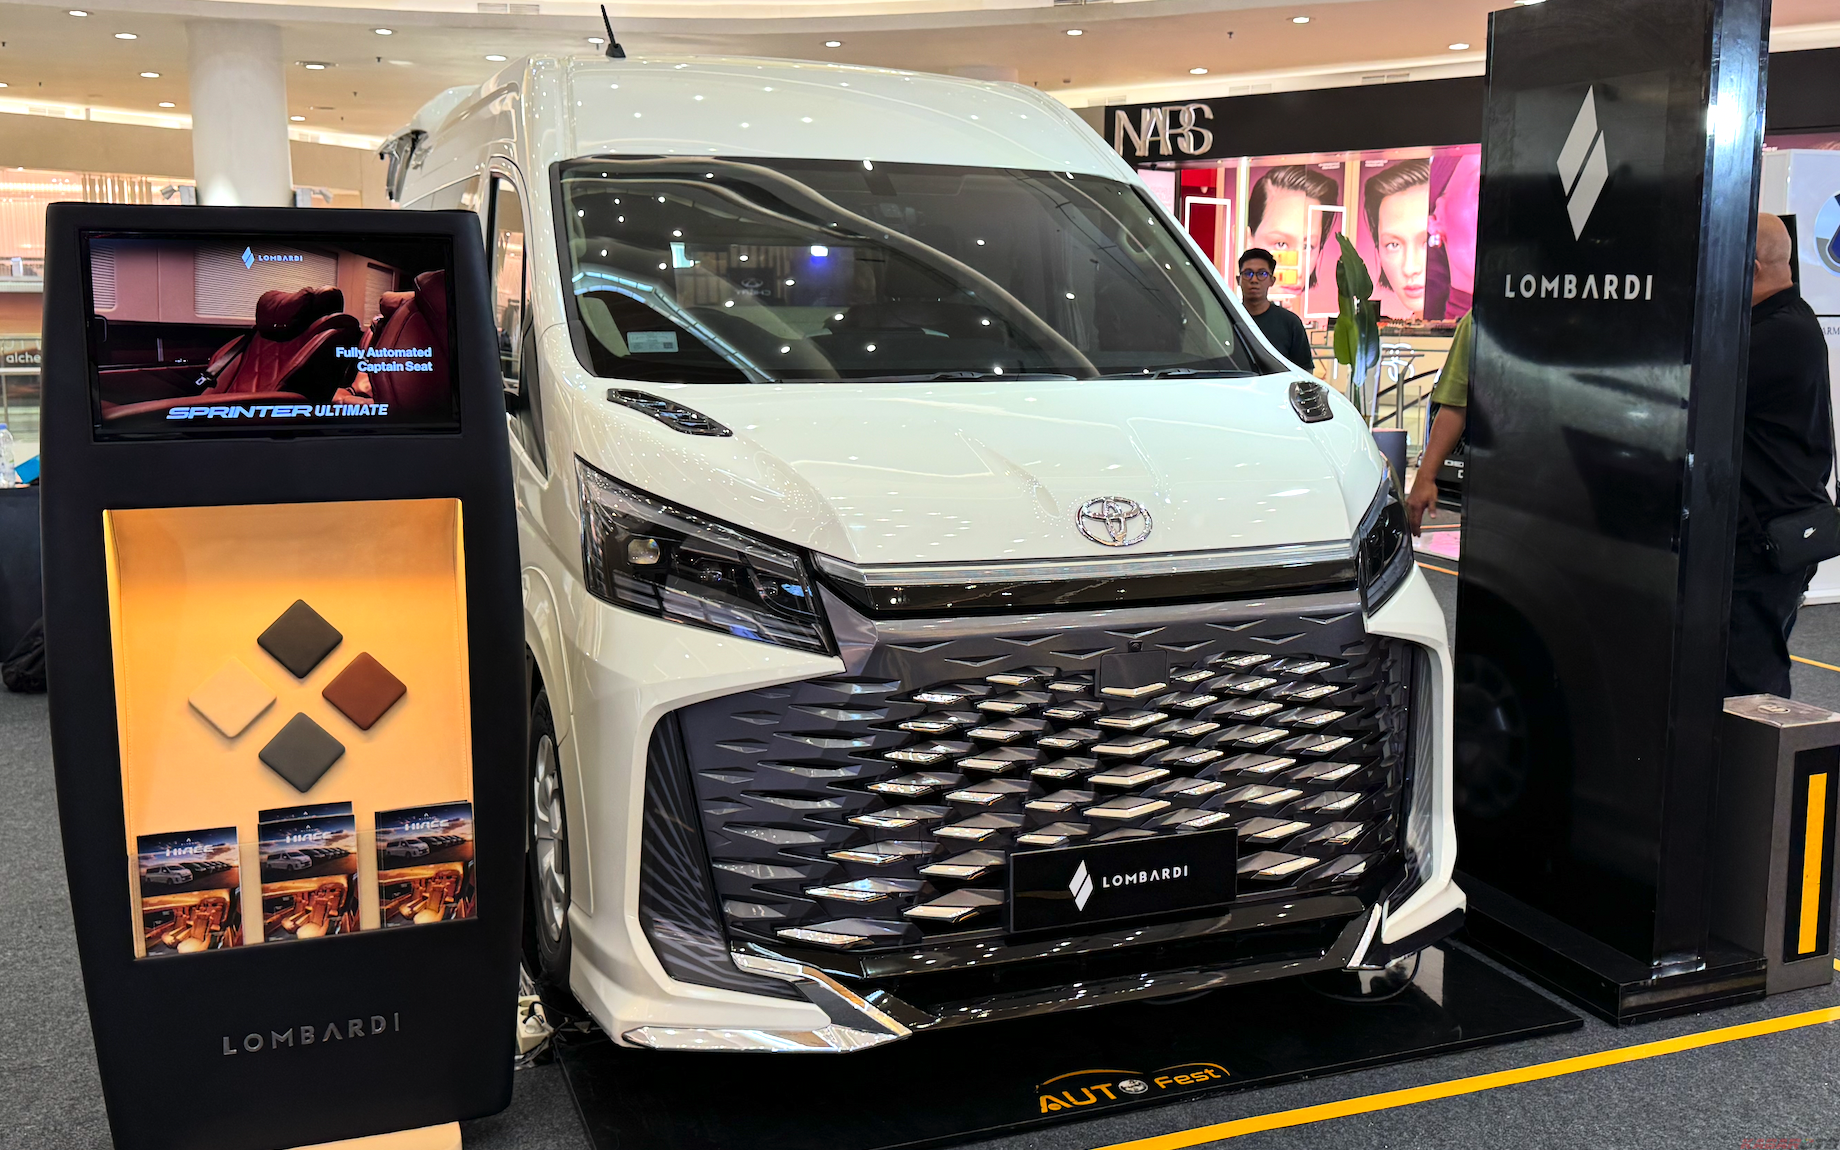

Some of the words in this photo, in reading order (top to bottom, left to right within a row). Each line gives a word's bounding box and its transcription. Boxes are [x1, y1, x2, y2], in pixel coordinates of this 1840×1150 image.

[1114, 103, 1214, 157] NARS
[258, 254, 303, 262] LOMBARDI
[1504, 274, 1654, 301] LOMBARDI
[335, 346, 365, 359] Fully
[366, 346, 433, 358] Automated
[356, 361, 405, 373] Captain
[404, 361, 434, 372] Seat
[166, 405, 314, 420] SPRINTER
[314, 403, 389, 417] ULTIMATE
[1102, 865, 1189, 889] LOMBARDI
[221, 1011, 402, 1056] LOMBARDI
